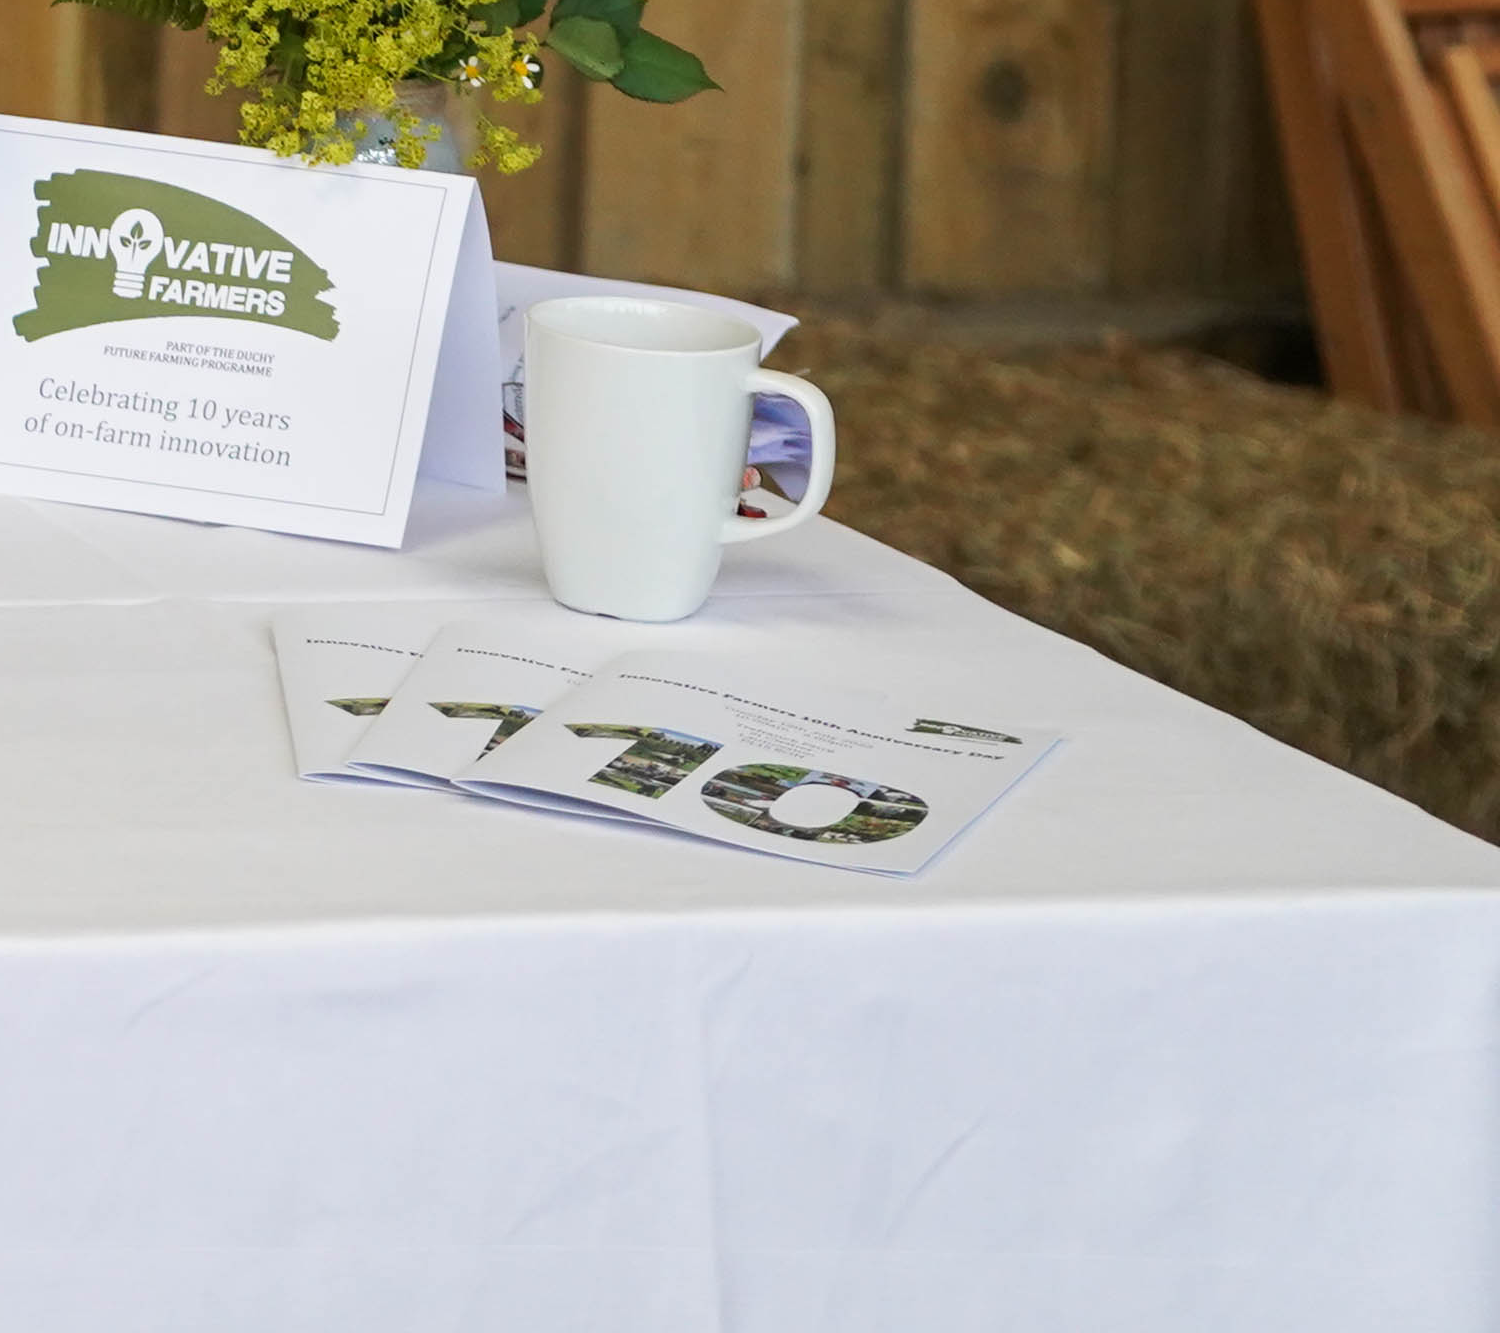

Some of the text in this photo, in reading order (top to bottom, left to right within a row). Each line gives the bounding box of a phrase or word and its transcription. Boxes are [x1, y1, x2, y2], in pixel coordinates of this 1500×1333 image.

[148, 275, 287, 317] FARMERS
[103, 345, 272, 377] FUTURE FARMING PROGRAMME
[165, 340, 275, 364] PART OF THE DUCHY
[39, 376, 291, 431] Celebrating 10 years
[24, 412, 291, 467] of on-farm innovation
[563, 722, 930, 845] 10
